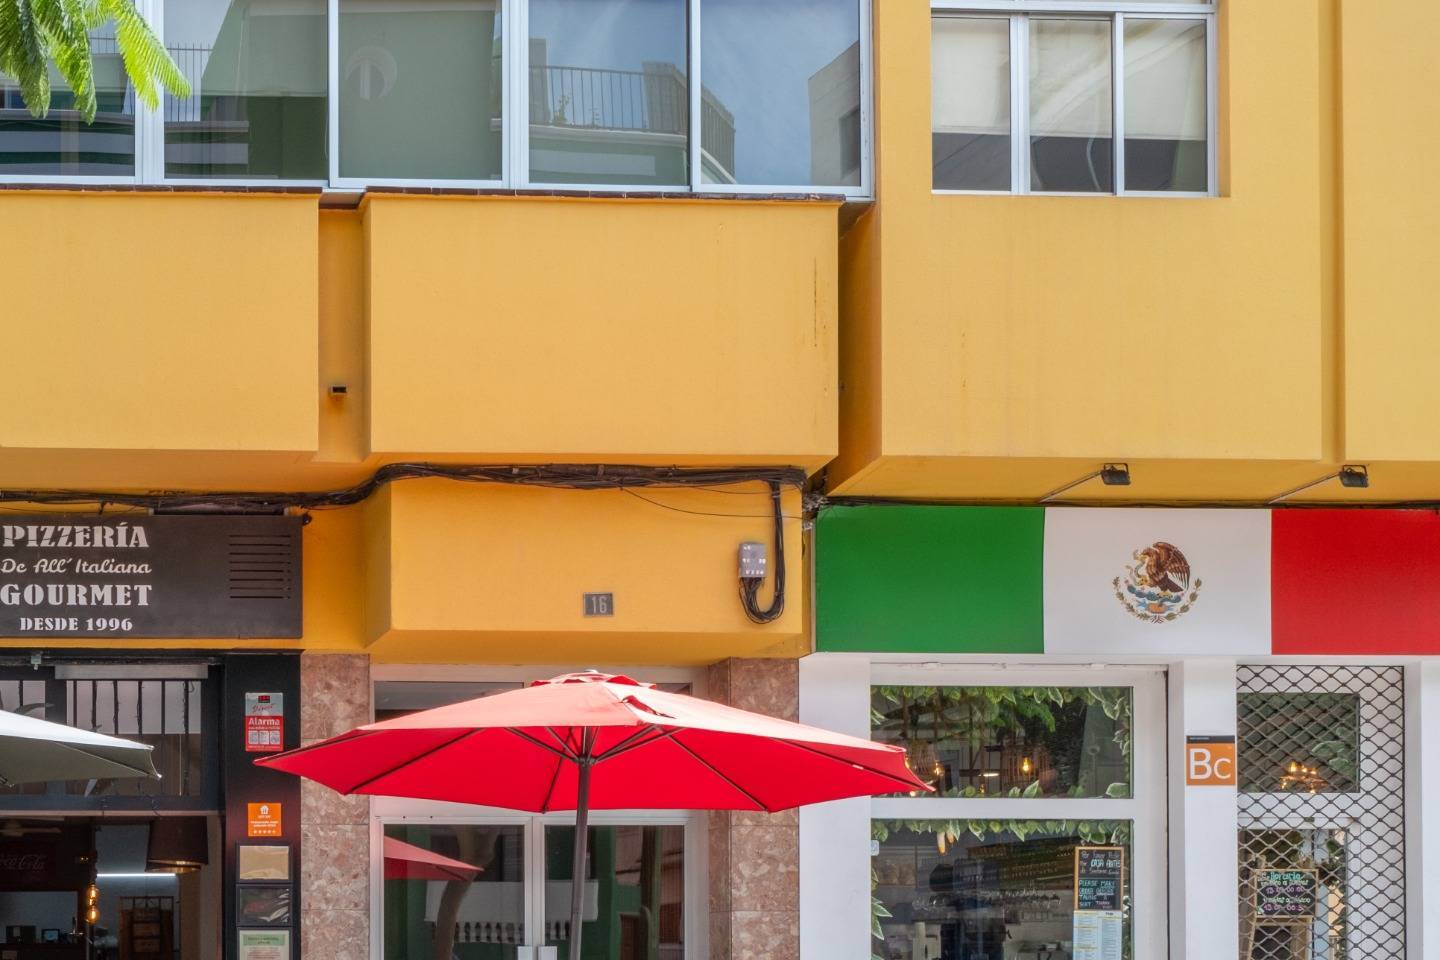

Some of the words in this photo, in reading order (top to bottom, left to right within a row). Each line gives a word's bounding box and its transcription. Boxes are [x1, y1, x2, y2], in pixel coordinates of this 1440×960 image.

[2, 521, 150, 548] PIZZERÍA
[0, 558, 28, 574] De
[75, 557, 152, 574] Italiana
[0, 583, 153, 606] GOURMET
[591, 596, 608, 614] 16
[19, 617, 79, 631] DESDE
[85, 617, 133, 631] 1996
[248, 717, 280, 726] Alarma
